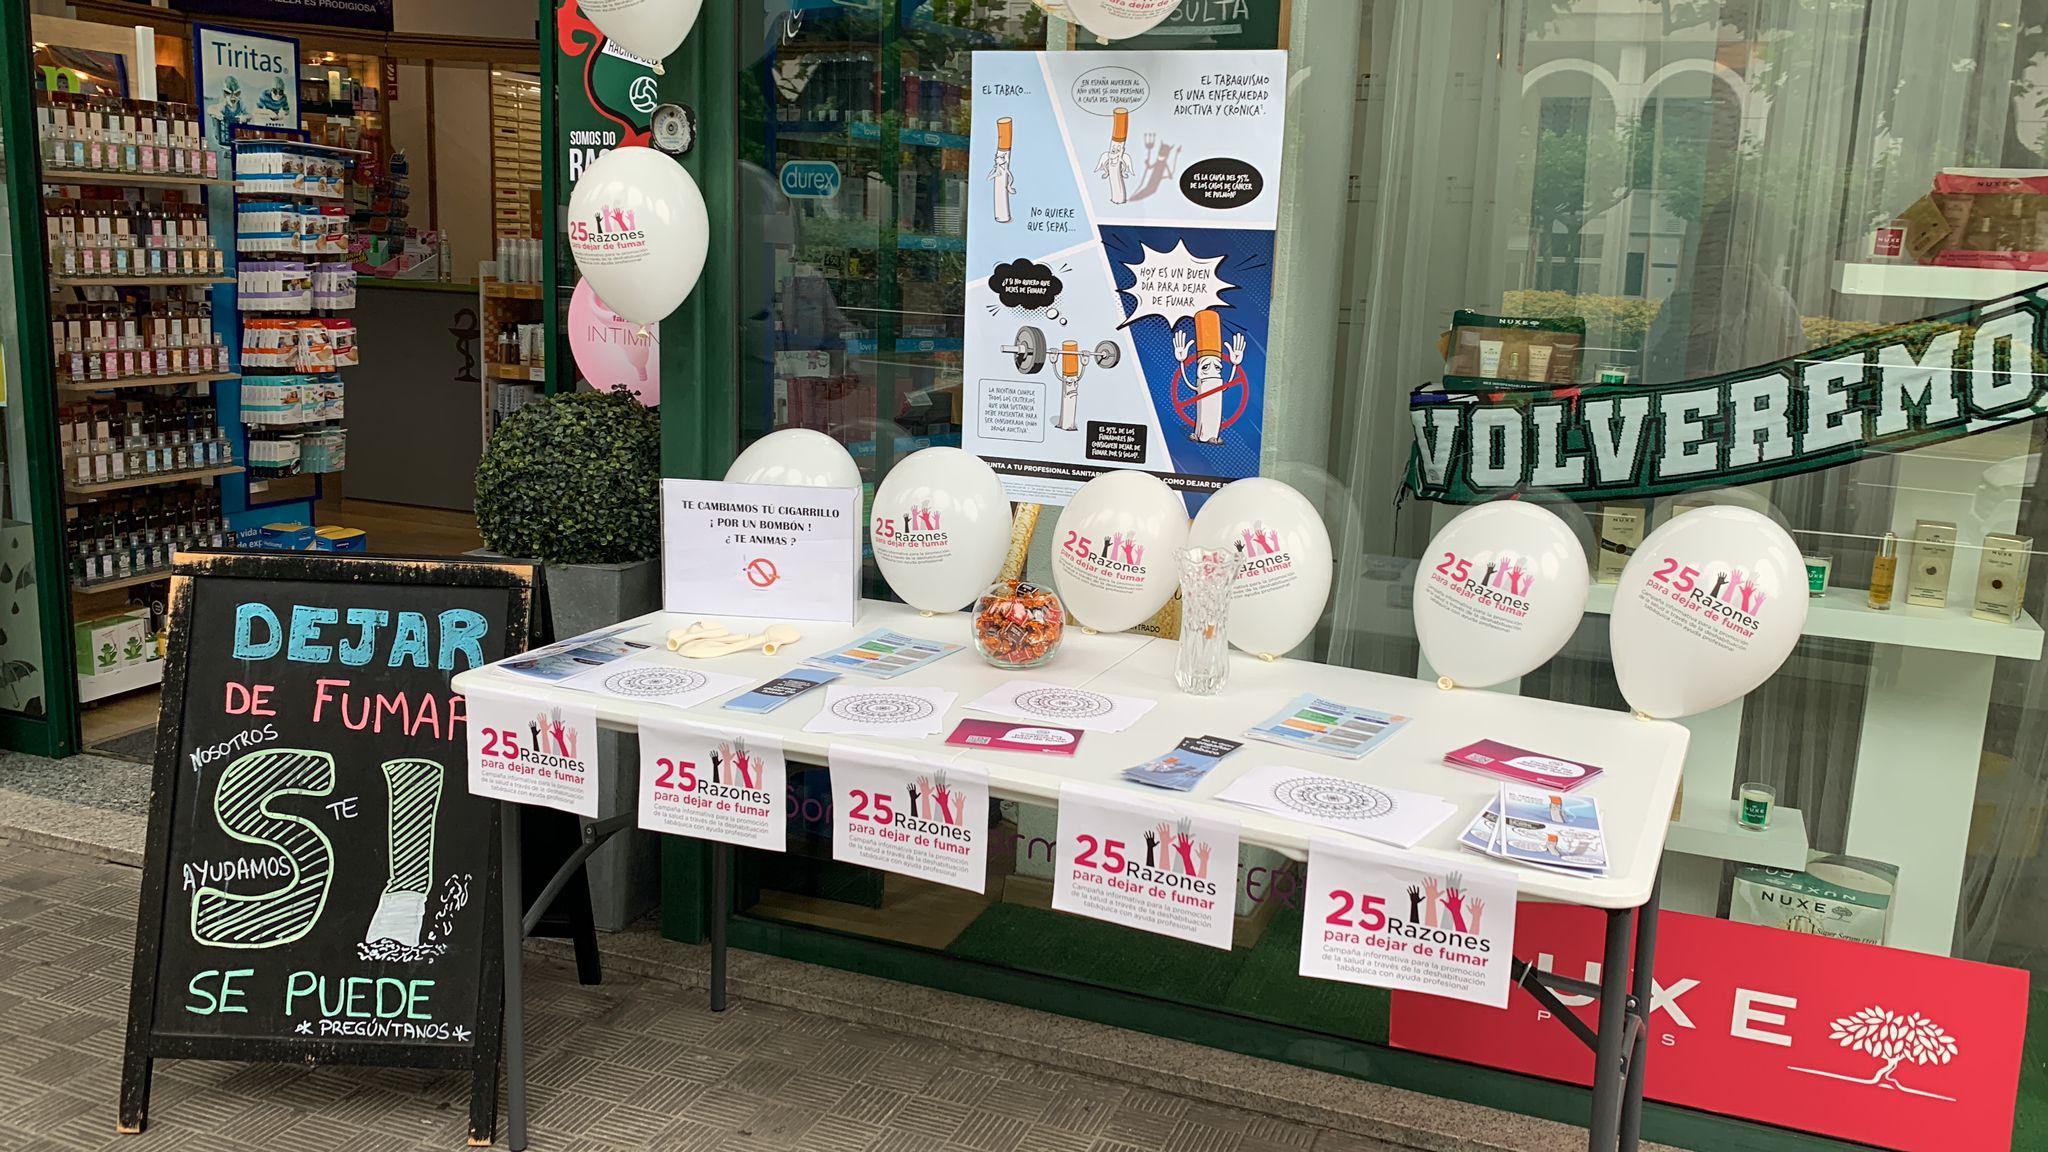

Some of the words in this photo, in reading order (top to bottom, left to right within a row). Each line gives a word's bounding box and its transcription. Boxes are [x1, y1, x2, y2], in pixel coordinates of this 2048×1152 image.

[319, 0, 376, 13] PRODIGIOSA
[212, 41, 282, 74] Tiritas
[982, 85, 992, 95] EL
[994, 84, 1031, 95] TABACO...
[1201, 75, 1212, 85] EL
[1214, 74, 1270, 86] TABAQUISMO
[1174, 89, 1183, 100] ES
[1187, 89, 1205, 101] UNA
[1208, 89, 1269, 101] ENFERMEDAD
[1174, 104, 1213, 115] ADICTIVA
[1216, 105, 1222, 115] Y
[570, 131, 601, 146] SOMOS
[603, 131, 616, 146] DO
[786, 167, 833, 190] durex
[1031, 207, 1042, 217] NO
[1044, 208, 1075, 219] QUIERE
[570, 221, 589, 242] 25
[589, 230, 645, 243] Razones
[1027, 222, 1043, 232] QUE
[1141, 267, 1156, 279] HOY
[1159, 267, 1168, 279] ES
[1171, 268, 1183, 279] UN
[1187, 268, 1210, 279] BUEN
[1141, 278, 1154, 291] DÍA
[1158, 282, 1179, 292] PARA
[1182, 283, 1207, 293] DEJAR
[1152, 296, 1163, 306] DE
[1166, 297, 1195, 307] FUMAR
[1499, 318, 1529, 326] NUXE
[986, 462, 1006, 470] UNTA
[1023, 465, 1070, 475] PROFESIONAL
[1164, 478, 1185, 486] COMO
[1186, 480, 1210, 488] DEJAR
[682, 500, 694, 509] TE
[697, 501, 759, 514] CAMBIAMOS
[762, 503, 775, 514] TÚ
[778, 506, 840, 519] CIGARRILLO
[717, 518, 738, 528] POR
[742, 519, 756, 529] UN
[759, 519, 804, 532] BOMBÓN
[875, 517, 895, 538] 25
[895, 531, 948, 542] Razones
[735, 534, 746, 544] TE
[749, 536, 788, 545] ANIMAS
[1063, 530, 1092, 559] 25
[1088, 552, 1147, 574] Razones
[1076, 558, 1098, 573] dejar
[1100, 567, 1113, 577] de
[1116, 571, 1145, 583] fumar
[1436, 552, 1473, 582] 25
[1464, 579, 1530, 612] Razones
[1431, 572, 1449, 586] para
[1450, 581, 1476, 599] dejar
[1478, 595, 1492, 607] de
[1494, 600, 1528, 618] fumar
[1652, 557, 1701, 593] 25
[1690, 587, 1760, 631] Razones
[1646, 578, 1669, 596] para
[1671, 590, 1702, 613] dejar
[1704, 610, 1719, 622] de
[1721, 617, 1755, 639] fumar
[233, 602, 489, 670] DEJAR
[225, 681, 277, 717] DE
[190, 723, 279, 772] NOSOTROS
[481, 727, 519, 760] 25
[520, 747, 585, 773] Razones
[481, 759, 505, 769] para
[507, 761, 535, 775] dejar
[538, 767, 552, 778] de
[554, 769, 585, 785] fumar
[655, 757, 697, 792] 25
[697, 779, 771, 805] Razones
[325, 797, 359, 820] TE
[654, 790, 680, 803] para
[683, 793, 712, 812] dejar
[716, 800, 731, 812] de
[735, 802, 770, 818] fumar
[849, 789, 894, 825] 25
[894, 812, 972, 842] Razones
[849, 821, 875, 836] para
[879, 827, 910, 846] dejar
[914, 834, 930, 847] de
[933, 838, 970, 856] fumar
[183, 856, 293, 891] AYUDAMOS
[1074, 833, 1126, 874] 25
[1126, 860, 1217, 896] Razones
[1072, 868, 1103, 885] para
[1107, 876, 1144, 896] dejar
[1148, 885, 1167, 900] de
[1171, 889, 1215, 911] fumar
[1762, 891, 1826, 913] NUXE
[1325, 889, 1386, 932] 25
[1387, 917, 1491, 952] Razones
[1323, 944, 1362, 958] Campaña
[1363, 950, 1410, 965] informativa
[1411, 957, 1430, 968] para
[1431, 960, 1439, 969] la
[1440, 963, 1486, 979] promoción
[1324, 928, 1360, 944] para
[1365, 933, 1408, 952] dejar
[1413, 942, 1434, 957] de
[1438, 946, 1489, 968] fumar
[1322, 953, 1332, 961] de
[1334, 954, 1341, 962] la
[1343, 956, 1365, 966] salud
[1374, 959, 1399, 972] través
[1401, 963, 1412, 973] de
[1413, 965, 1421, 974] la
[1423, 967, 1486, 987] deshabituación
[1336, 963, 1377, 977] tabáquica
[1379, 969, 1395, 978] con
[1396, 971, 1421, 983] ayuda
[1422, 976, 1469, 991] profesional
[185, 969, 255, 1015] SE
[285, 970, 436, 1020] PUEDE
[1538, 952, 1797, 1048] UXE
